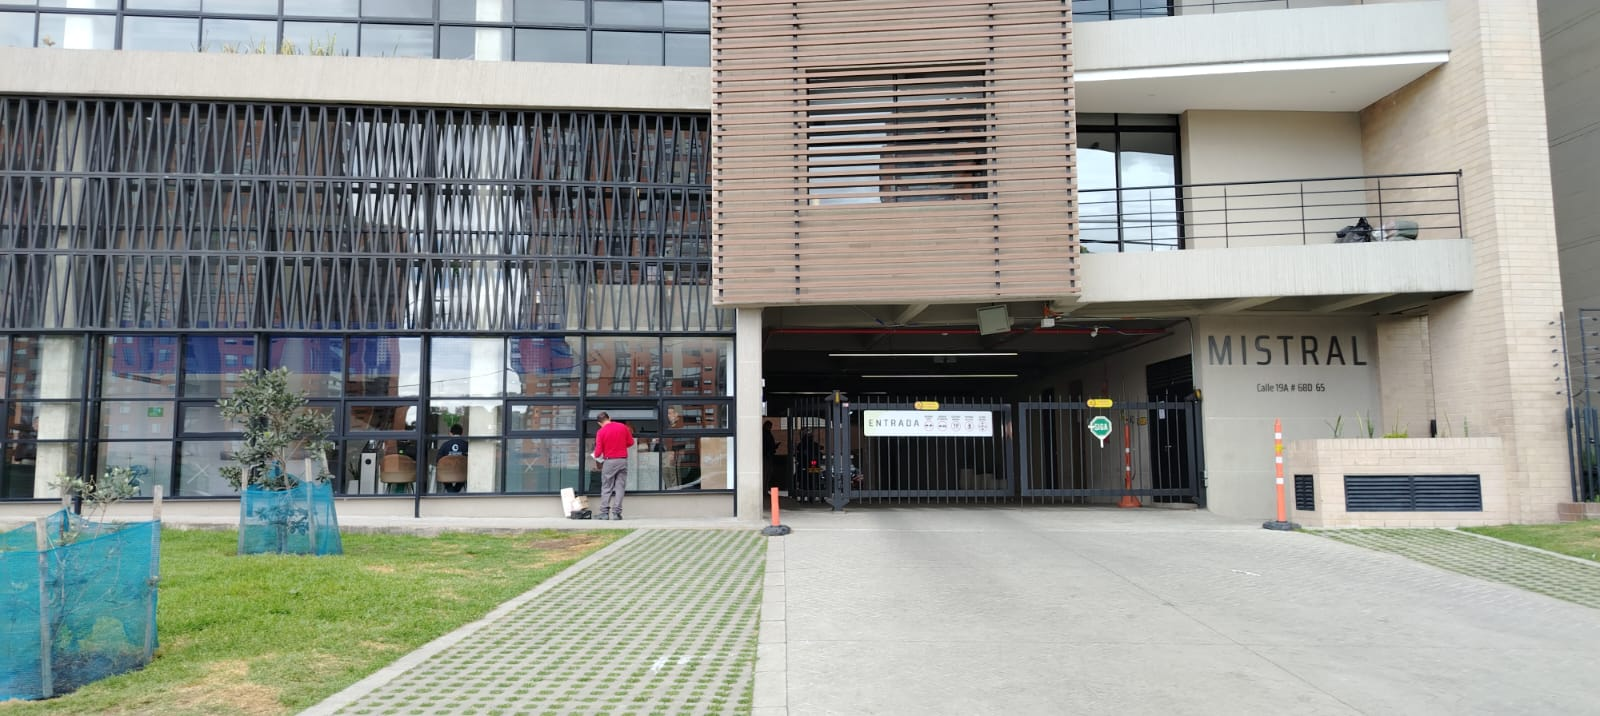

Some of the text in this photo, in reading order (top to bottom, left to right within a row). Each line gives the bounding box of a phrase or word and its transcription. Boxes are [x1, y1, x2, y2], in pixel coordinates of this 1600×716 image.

[1208, 335, 1367, 366] MISTRAL
[1256, 383, 1275, 392] Calle
[1275, 383, 1289, 392] 19A
[1315, 383, 1326, 392] 65
[868, 418, 920, 428] ENTRADA
